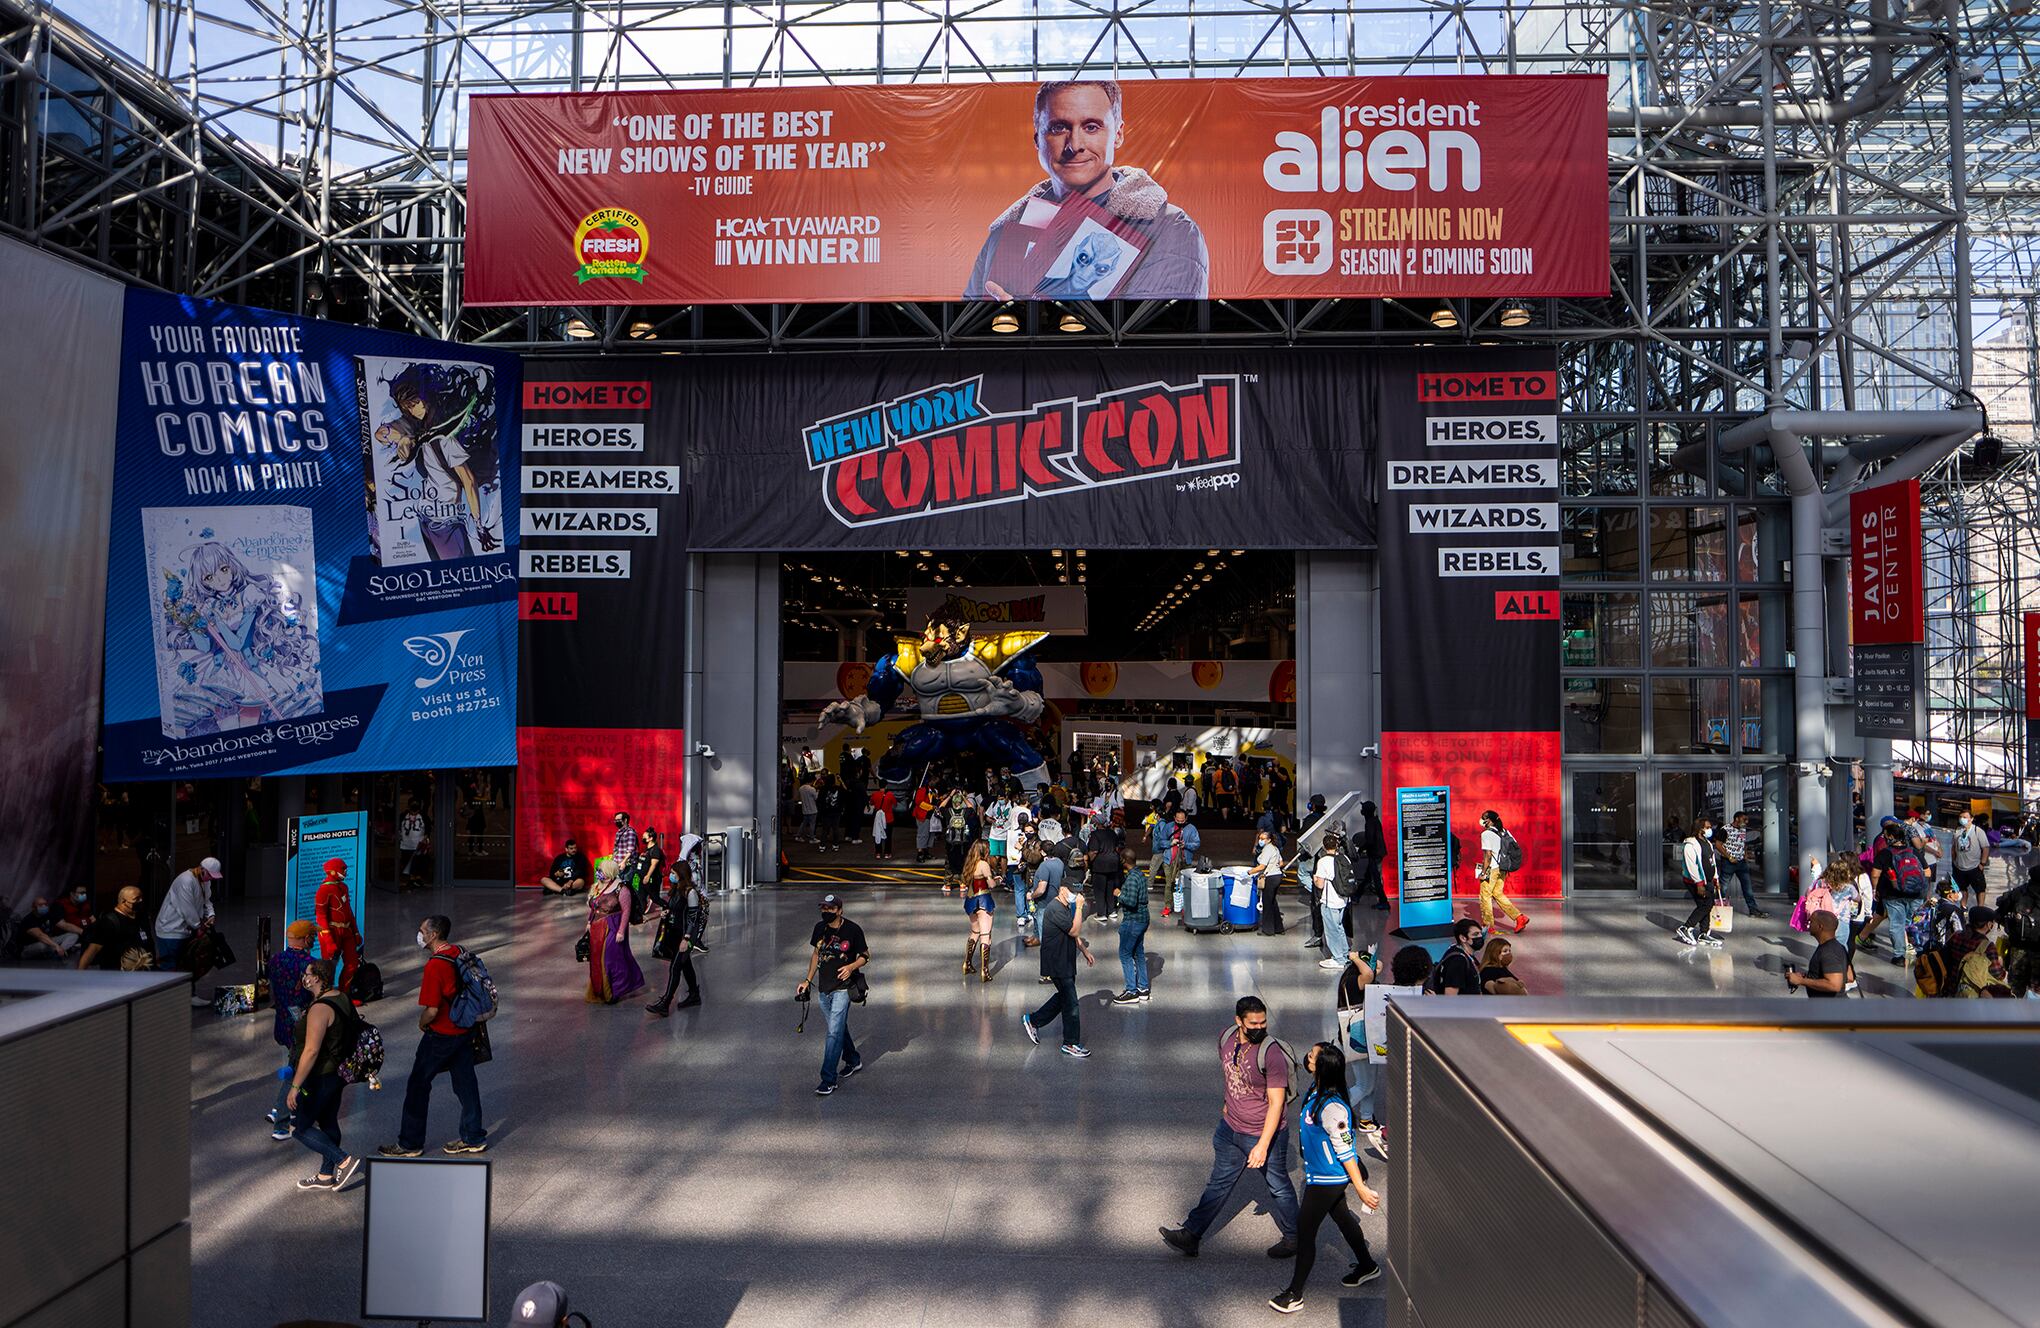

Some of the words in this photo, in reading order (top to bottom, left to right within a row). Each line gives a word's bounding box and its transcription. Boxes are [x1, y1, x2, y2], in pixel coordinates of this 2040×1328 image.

[1344, 97, 1480, 127] resident
[684, 114, 713, 140] OF
[721, 112, 765, 139] THE
[773, 110, 834, 137] BEST
[558, 148, 612, 174] NEW
[620, 145, 707, 174] SHOWS
[715, 144, 745, 172] OF
[752, 143, 797, 170] THE
[1262, 106, 1482, 193] alien
[688, 178, 711, 195] -TV
[714, 176, 753, 195] GUIDE
[586, 210, 639, 227] CERTIFIED
[1340, 208, 1452, 242] STREAMING
[1458, 207, 1504, 241] NOW
[584, 238, 640, 253] FRESH
[736, 238, 860, 266] WINNER
[585, 266, 638, 275] Tomatoes
[592, 258, 627, 267] Rotten
[1340, 248, 1400, 275] SEASON
[1406, 249, 1416, 275] 2
[1422, 248, 1484, 275] COMING
[1490, 248, 1532, 274] SOON
[150, 326, 206, 353] YOUR
[212, 327, 303, 353] FAVORITE
[141, 361, 326, 406] KOREAN
[1424, 378, 1504, 397] HOME
[1509, 377, 1546, 395] TO
[534, 386, 608, 404] HOME
[612, 386, 647, 404] TO
[156, 410, 329, 456] COMICS
[810, 411, 882, 462] NEW
[890, 383, 982, 436] YORK
[1432, 420, 1545, 442] HEROES,
[533, 428, 637, 449] HEROES,
[836, 411, 1062, 516] COMIC
[1082, 385, 1229, 474] CON
[184, 466, 226, 494] NOW
[235, 465, 254, 492] IN
[263, 461, 322, 490] PRINT!
[532, 470, 673, 492] DREAMERS,
[1393, 464, 1546, 486] DREAMERS,
[384, 472, 438, 502] Solo
[1176, 484, 1186, 492] by
[384, 499, 467, 521] Leveling
[1416, 508, 1547, 530] WIZARDS,
[531, 512, 652, 534] WIZARDS,
[530, 555, 624, 576] REBELS,
[1444, 552, 1548, 574] REBELS,
[1862, 511, 1881, 622] JAVITS
[1885, 506, 1900, 620] CENTER
[366, 572, 422, 596] SOLO
[422, 562, 517, 588] LEVELING
[529, 597, 572, 615] ALL
[1502, 596, 1550, 614] ALL
[457, 654, 484, 668] Yen
[450, 669, 486, 684] Press
[422, 692, 452, 706] Visit
[456, 691, 470, 700] us
[474, 687, 487, 697] at
[412, 706, 452, 721] Booth
[456, 696, 500, 712] #2725!
[155, 728, 273, 765] Abandoned
[276, 715, 359, 745] Empress
[304, 832, 331, 840] FILMING
[332, 829, 357, 838] NOTICE
